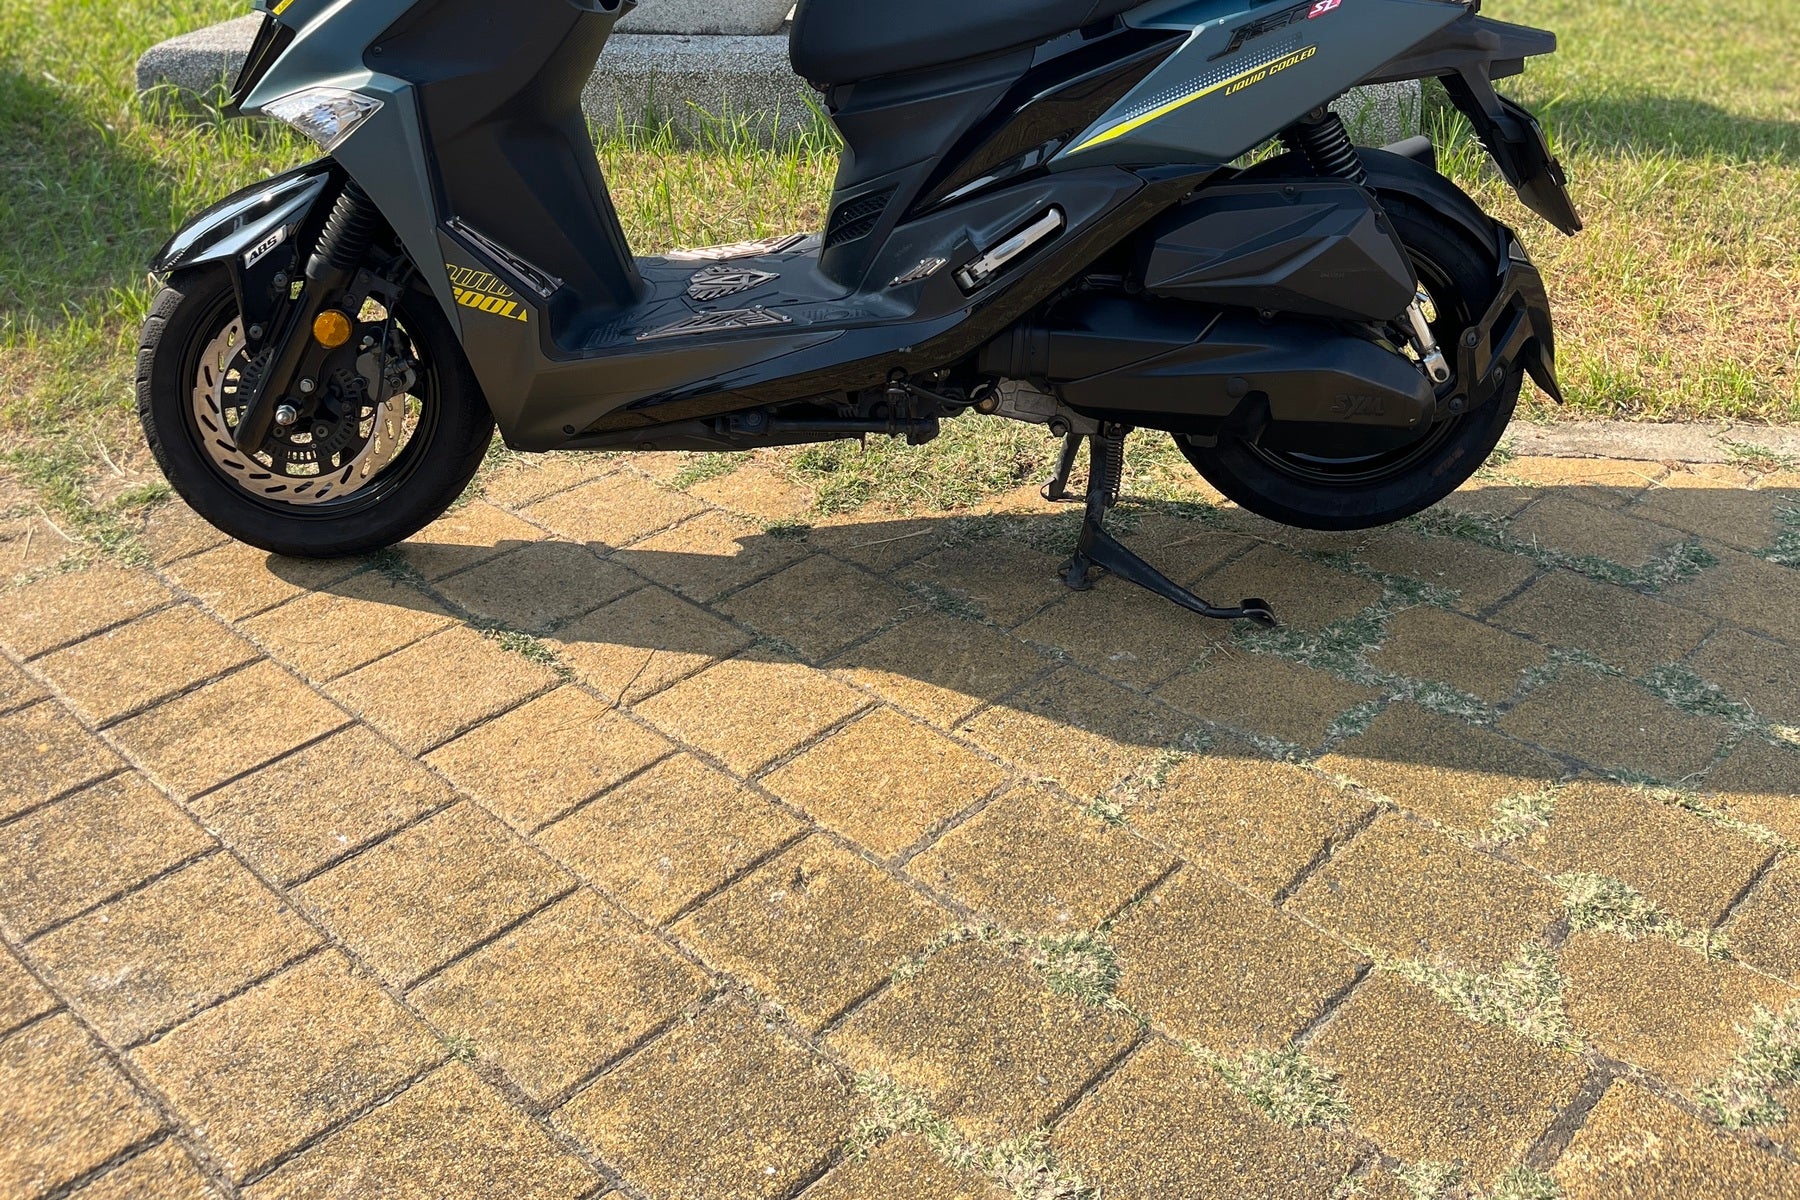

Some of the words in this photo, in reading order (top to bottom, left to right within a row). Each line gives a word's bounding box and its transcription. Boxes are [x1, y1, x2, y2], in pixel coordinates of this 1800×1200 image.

[1224, 70, 1267, 96] LIQUID
[1268, 46, 1317, 76] COOLED
[248, 235, 278, 264] ABS
[1329, 392, 1386, 419] SYM
